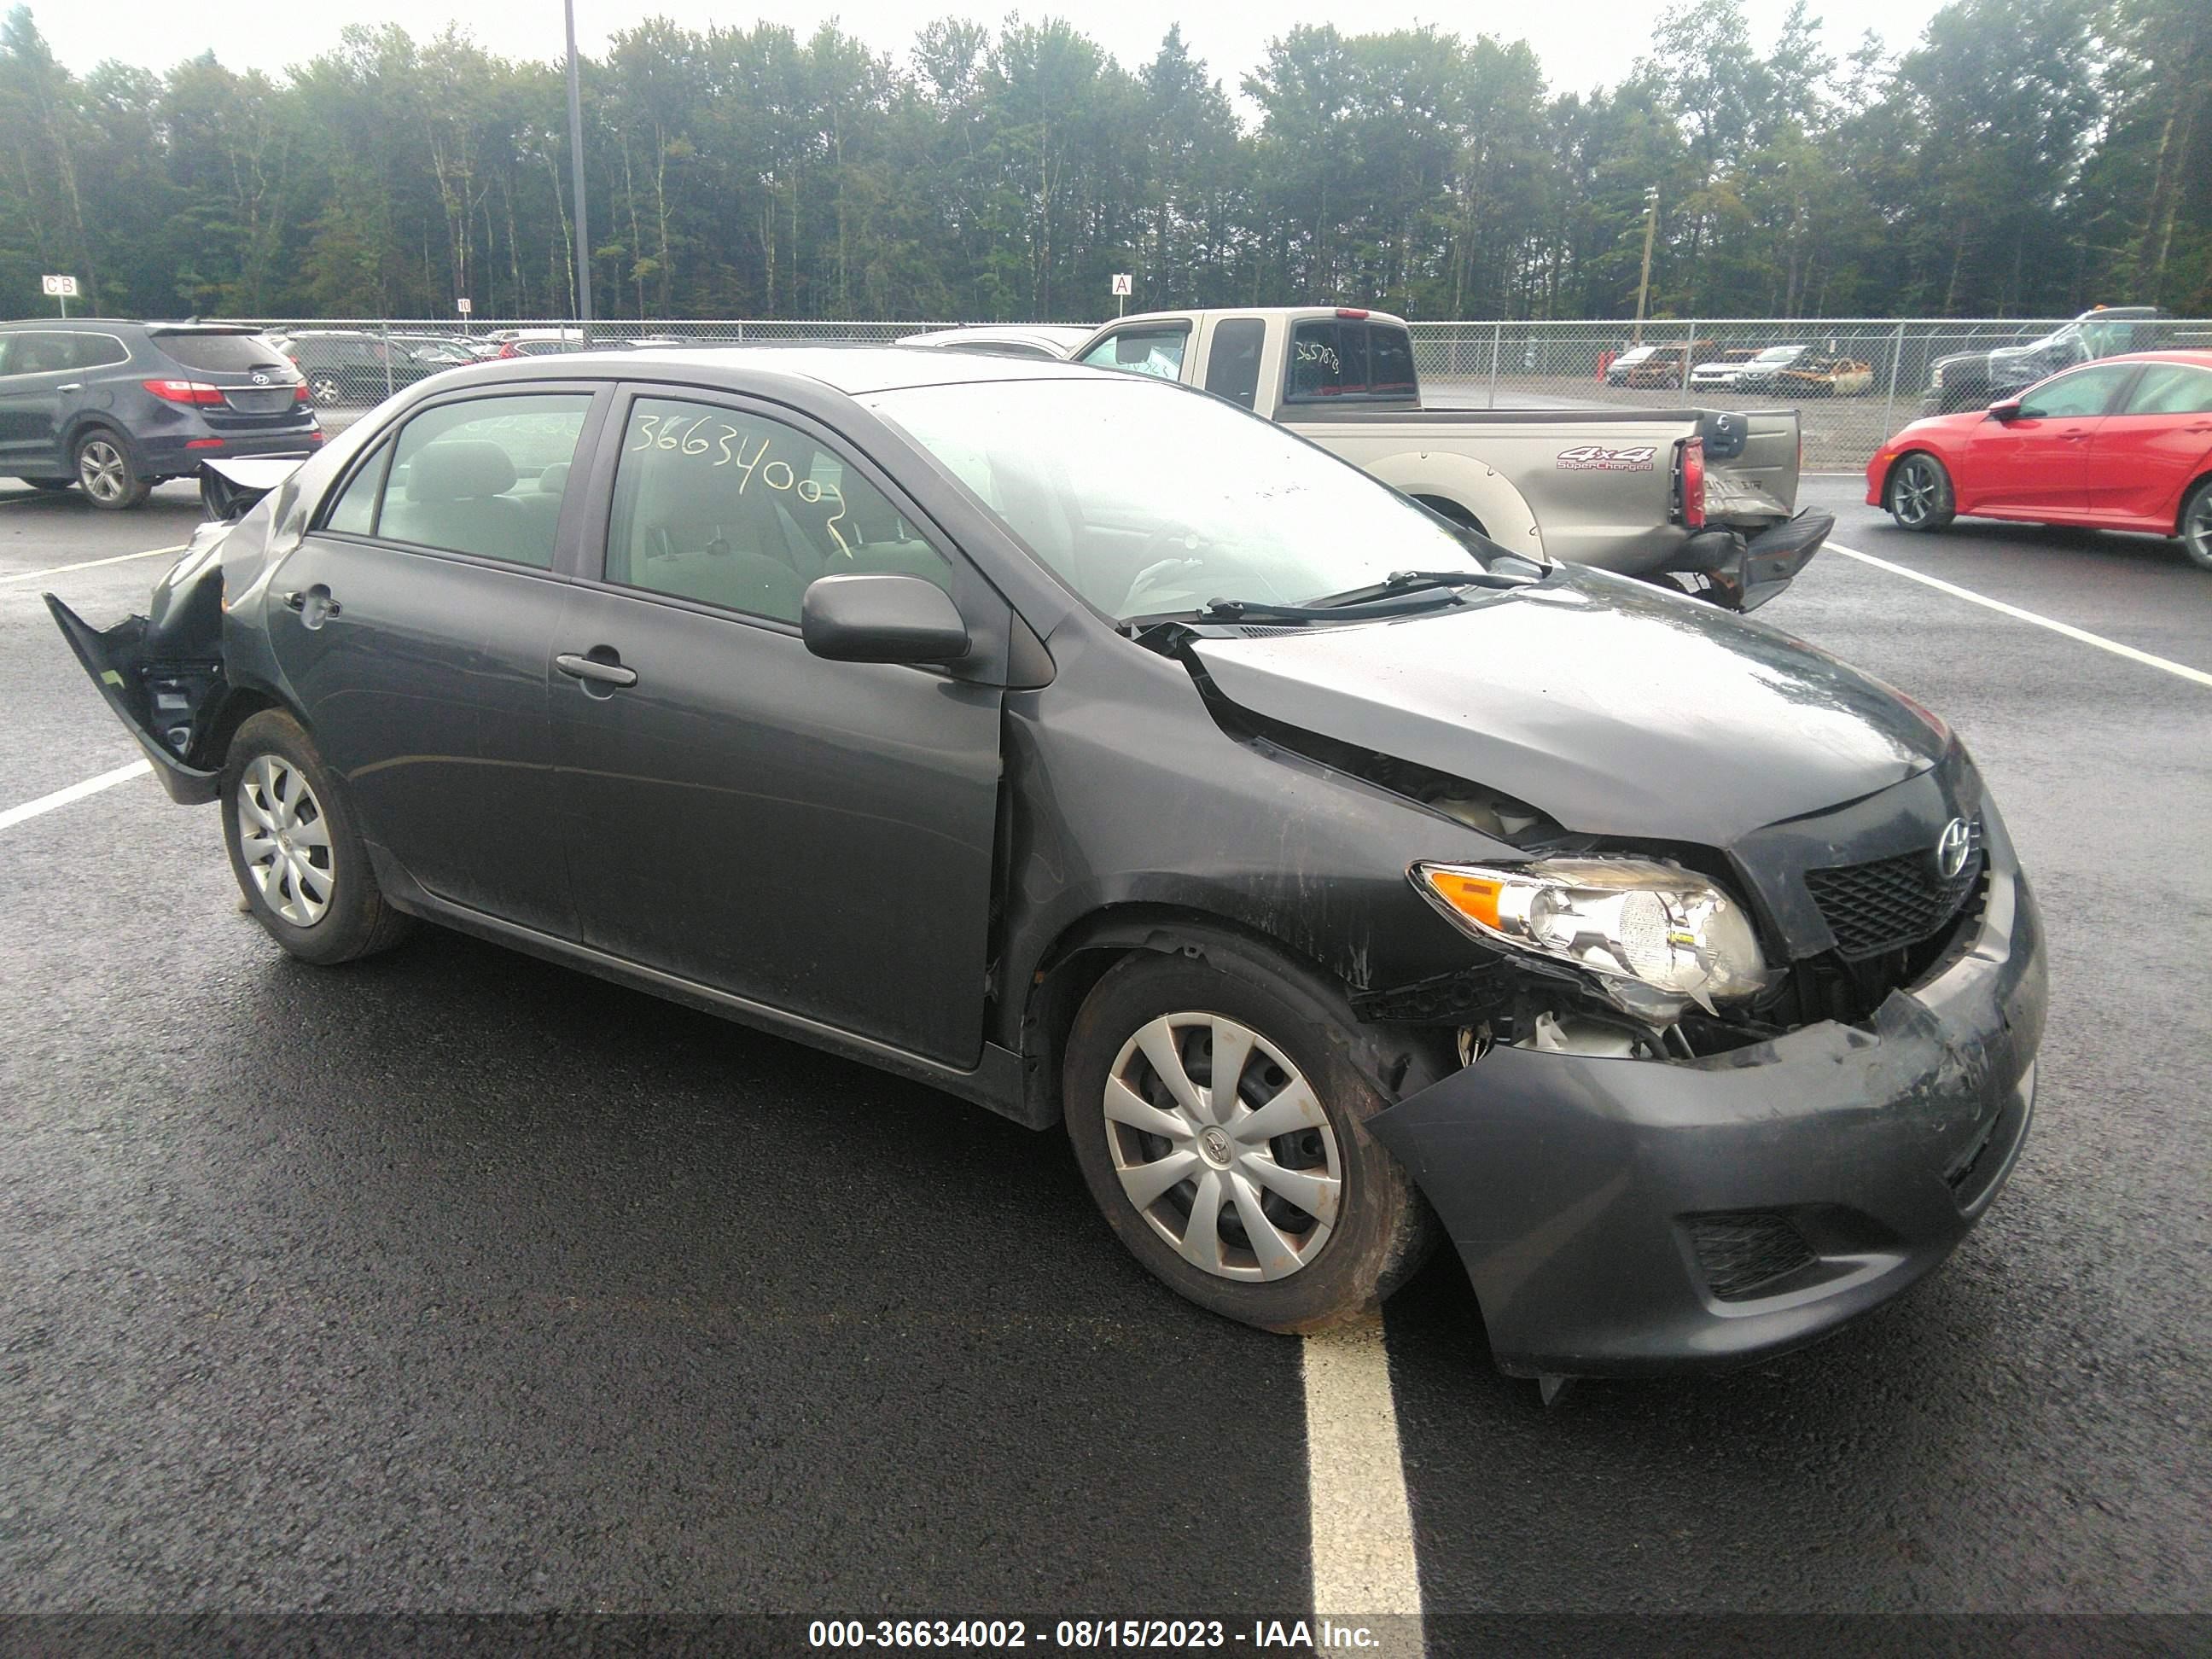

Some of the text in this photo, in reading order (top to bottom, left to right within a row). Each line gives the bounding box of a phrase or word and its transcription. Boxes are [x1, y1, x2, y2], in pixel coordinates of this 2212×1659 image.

[1115, 276, 1128, 293] A
[459, 300, 469, 311] 10
[1557, 445, 1657, 464] 4x4
[1556, 461, 1654, 473] SuperCharged
[632, 415, 853, 560] 36634002
